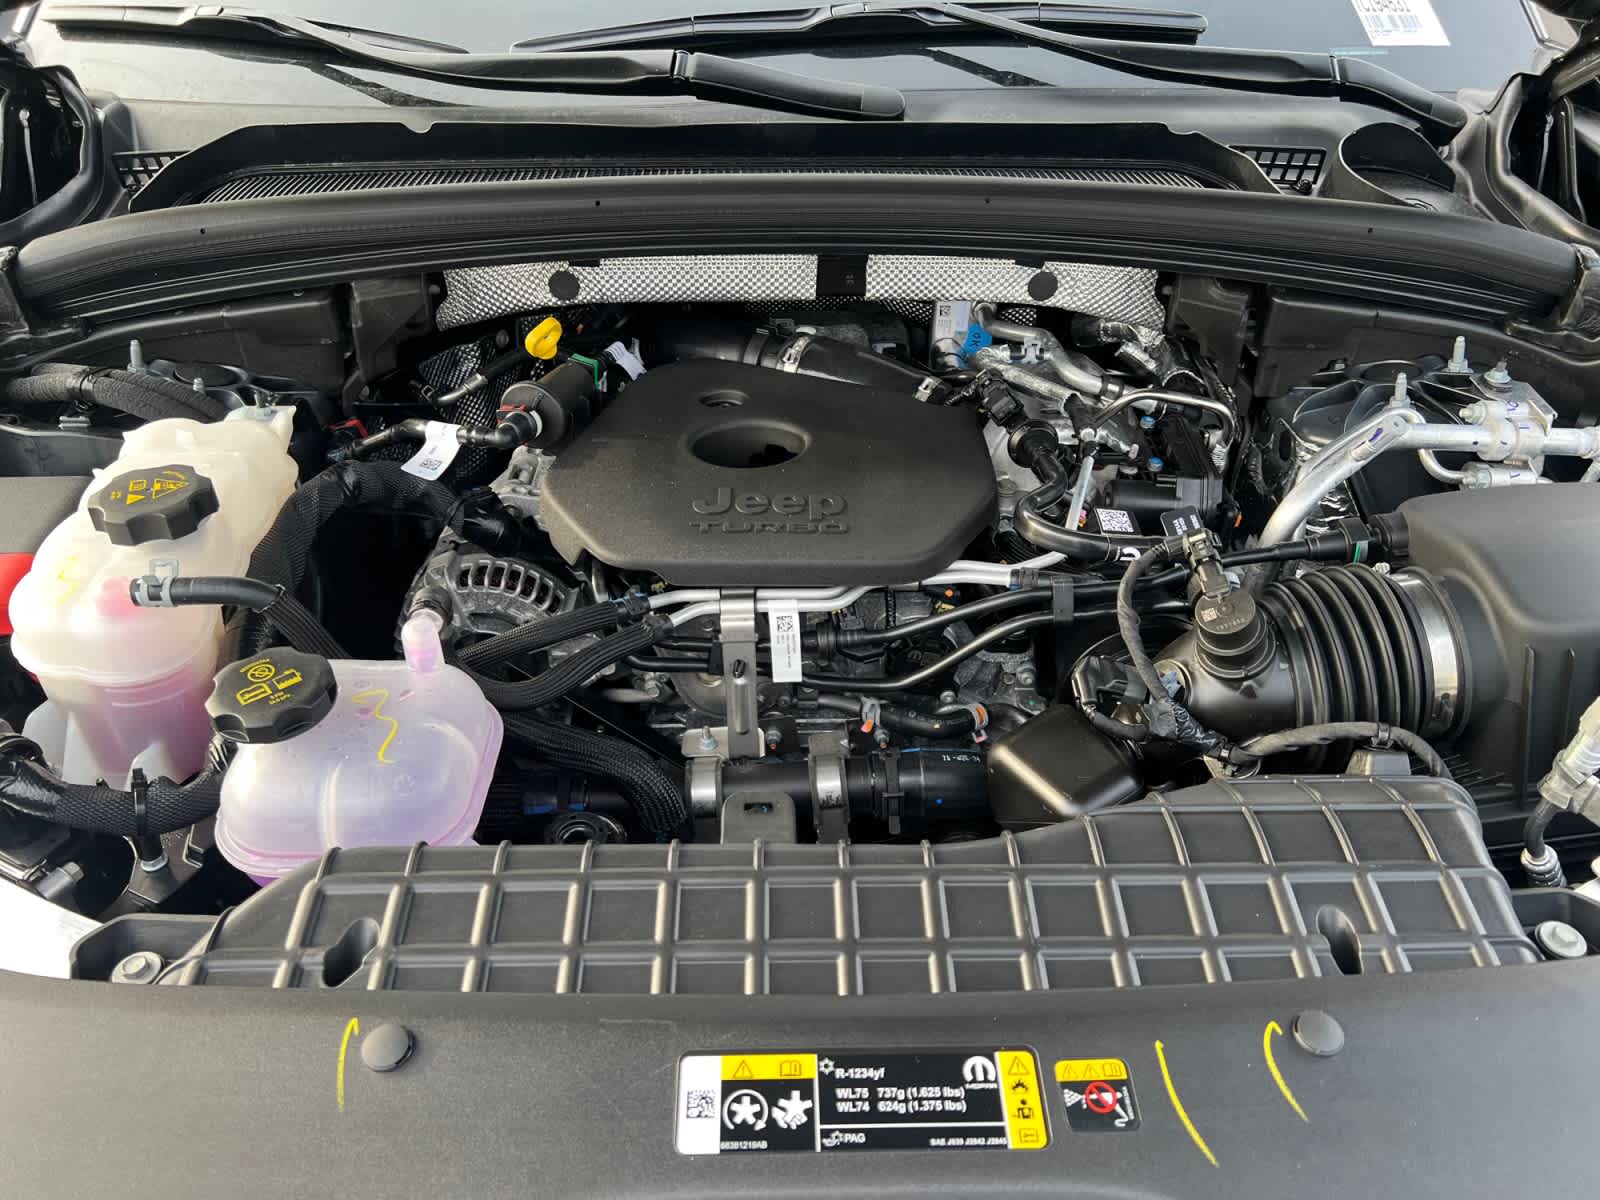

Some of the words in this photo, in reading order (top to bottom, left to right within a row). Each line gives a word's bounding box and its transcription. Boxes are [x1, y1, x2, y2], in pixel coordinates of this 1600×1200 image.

[692, 487, 848, 521] Jeep
[688, 520, 850, 535] TURBO
[834, 1067, 886, 1081] R-1234yf
[834, 1087, 870, 1099] WL75
[876, 1087, 906, 1101] 737g
[943, 1086, 966, 1100] lbs)
[835, 1100, 871, 1113] WL74
[877, 1100, 907, 1114] 624g
[908, 1100, 943, 1114] (1.375
[944, 1100, 968, 1114] lbs)
[844, 1132, 867, 1144] PAG
